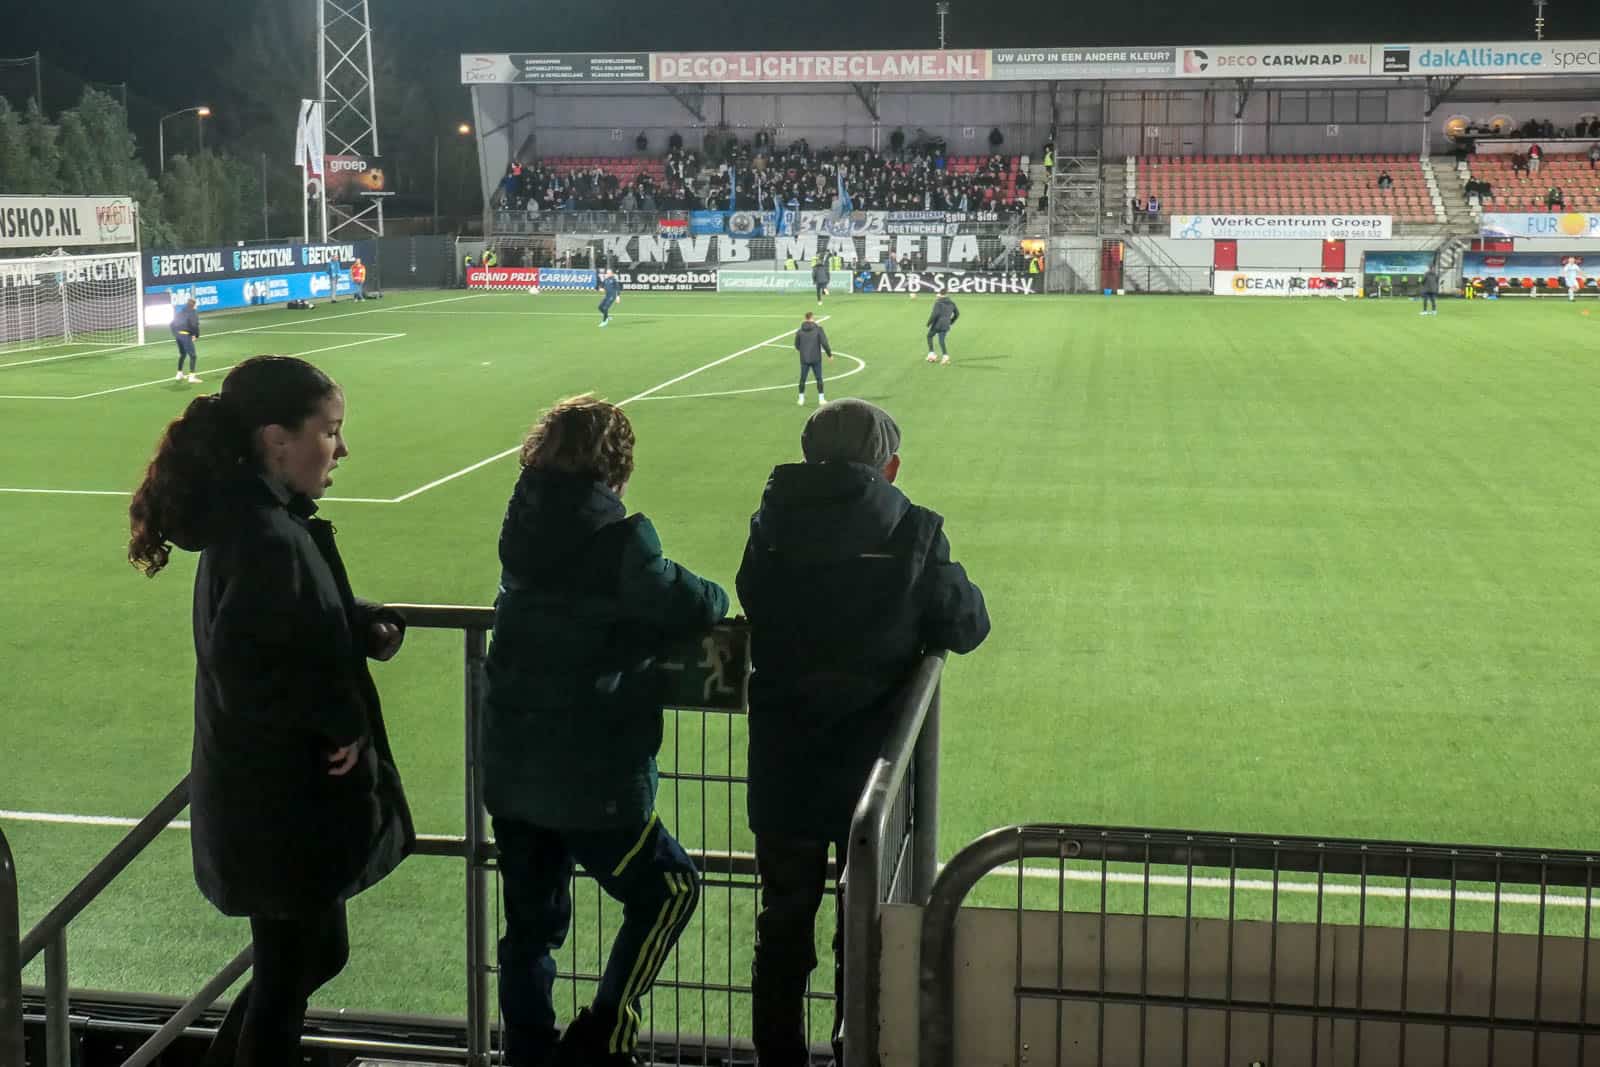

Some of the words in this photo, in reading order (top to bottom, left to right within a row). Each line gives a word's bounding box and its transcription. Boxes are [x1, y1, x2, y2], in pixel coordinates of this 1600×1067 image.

[998, 54, 1014, 62] UW
[1017, 54, 1045, 62] AUTO
[1048, 53, 1058, 62] IN
[1061, 53, 1082, 61] EEN
[1085, 53, 1127, 61] ANDERE
[1130, 52, 1170, 60] KLEUR?
[1217, 56, 1257, 66] DECO
[1419, 48, 1543, 67] dakAlliance
[662, 53, 978, 79] DECO-LICHTRECLAME.NL
[330, 160, 367, 172] groep
[1211, 217, 1327, 227] WerkCentrum
[1332, 217, 1382, 228] Groep
[308, 245, 356, 265] BETCITY.NL
[603, 234, 750, 263] KNVB
[775, 234, 979, 263] MAFFIA
[161, 252, 225, 276] BETCITY.NL
[240, 247, 295, 270] BETCITY.NL
[470, 272, 509, 282] GRAND
[510, 272, 538, 282] PRIX
[540, 273, 593, 283] CARWASH
[637, 270, 717, 283] oorschot
[878, 273, 921, 292] A2B
[934, 273, 1034, 294] Security
[1236, 278, 1284, 289] OCEAN
